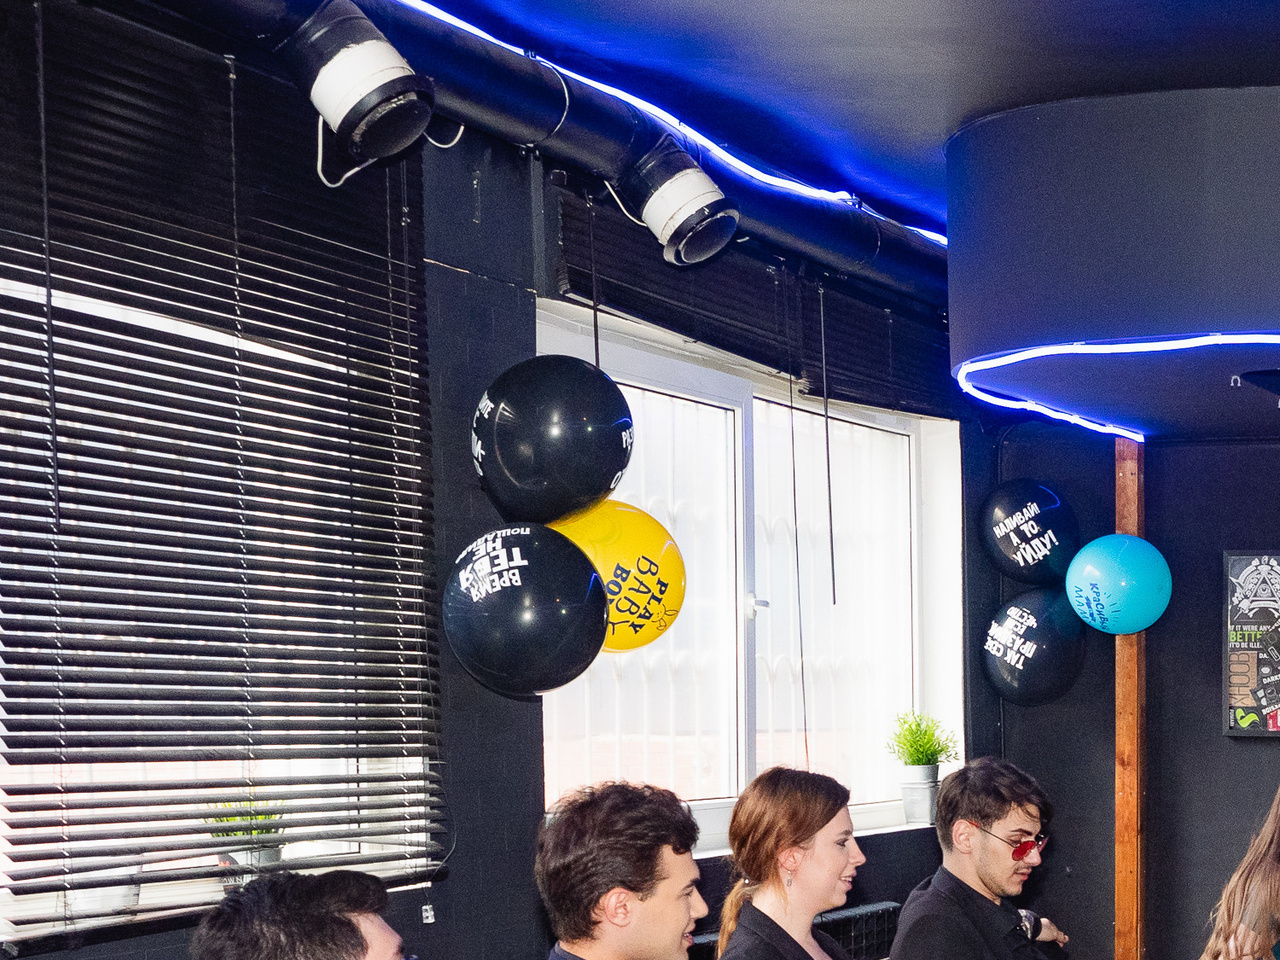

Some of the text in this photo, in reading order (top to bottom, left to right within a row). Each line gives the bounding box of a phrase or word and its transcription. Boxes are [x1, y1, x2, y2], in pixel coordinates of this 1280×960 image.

[993, 502, 1040, 539] НАЛИВАЙ!
[1009, 531, 1021, 546] А
[472, 537, 502, 561] НЕ
[1012, 529, 1059, 567] УЙДУ!
[458, 547, 529, 591] ТЕБЯ
[470, 569, 522, 602] ВРЕМЯ
[605, 563, 631, 605] BO
[608, 555, 659, 635] BABY
[629, 577, 669, 634] PLAY
[983, 636, 1025, 670] ТАК СЕБЕ
[1229, 631, 1266, 642] BETTE
